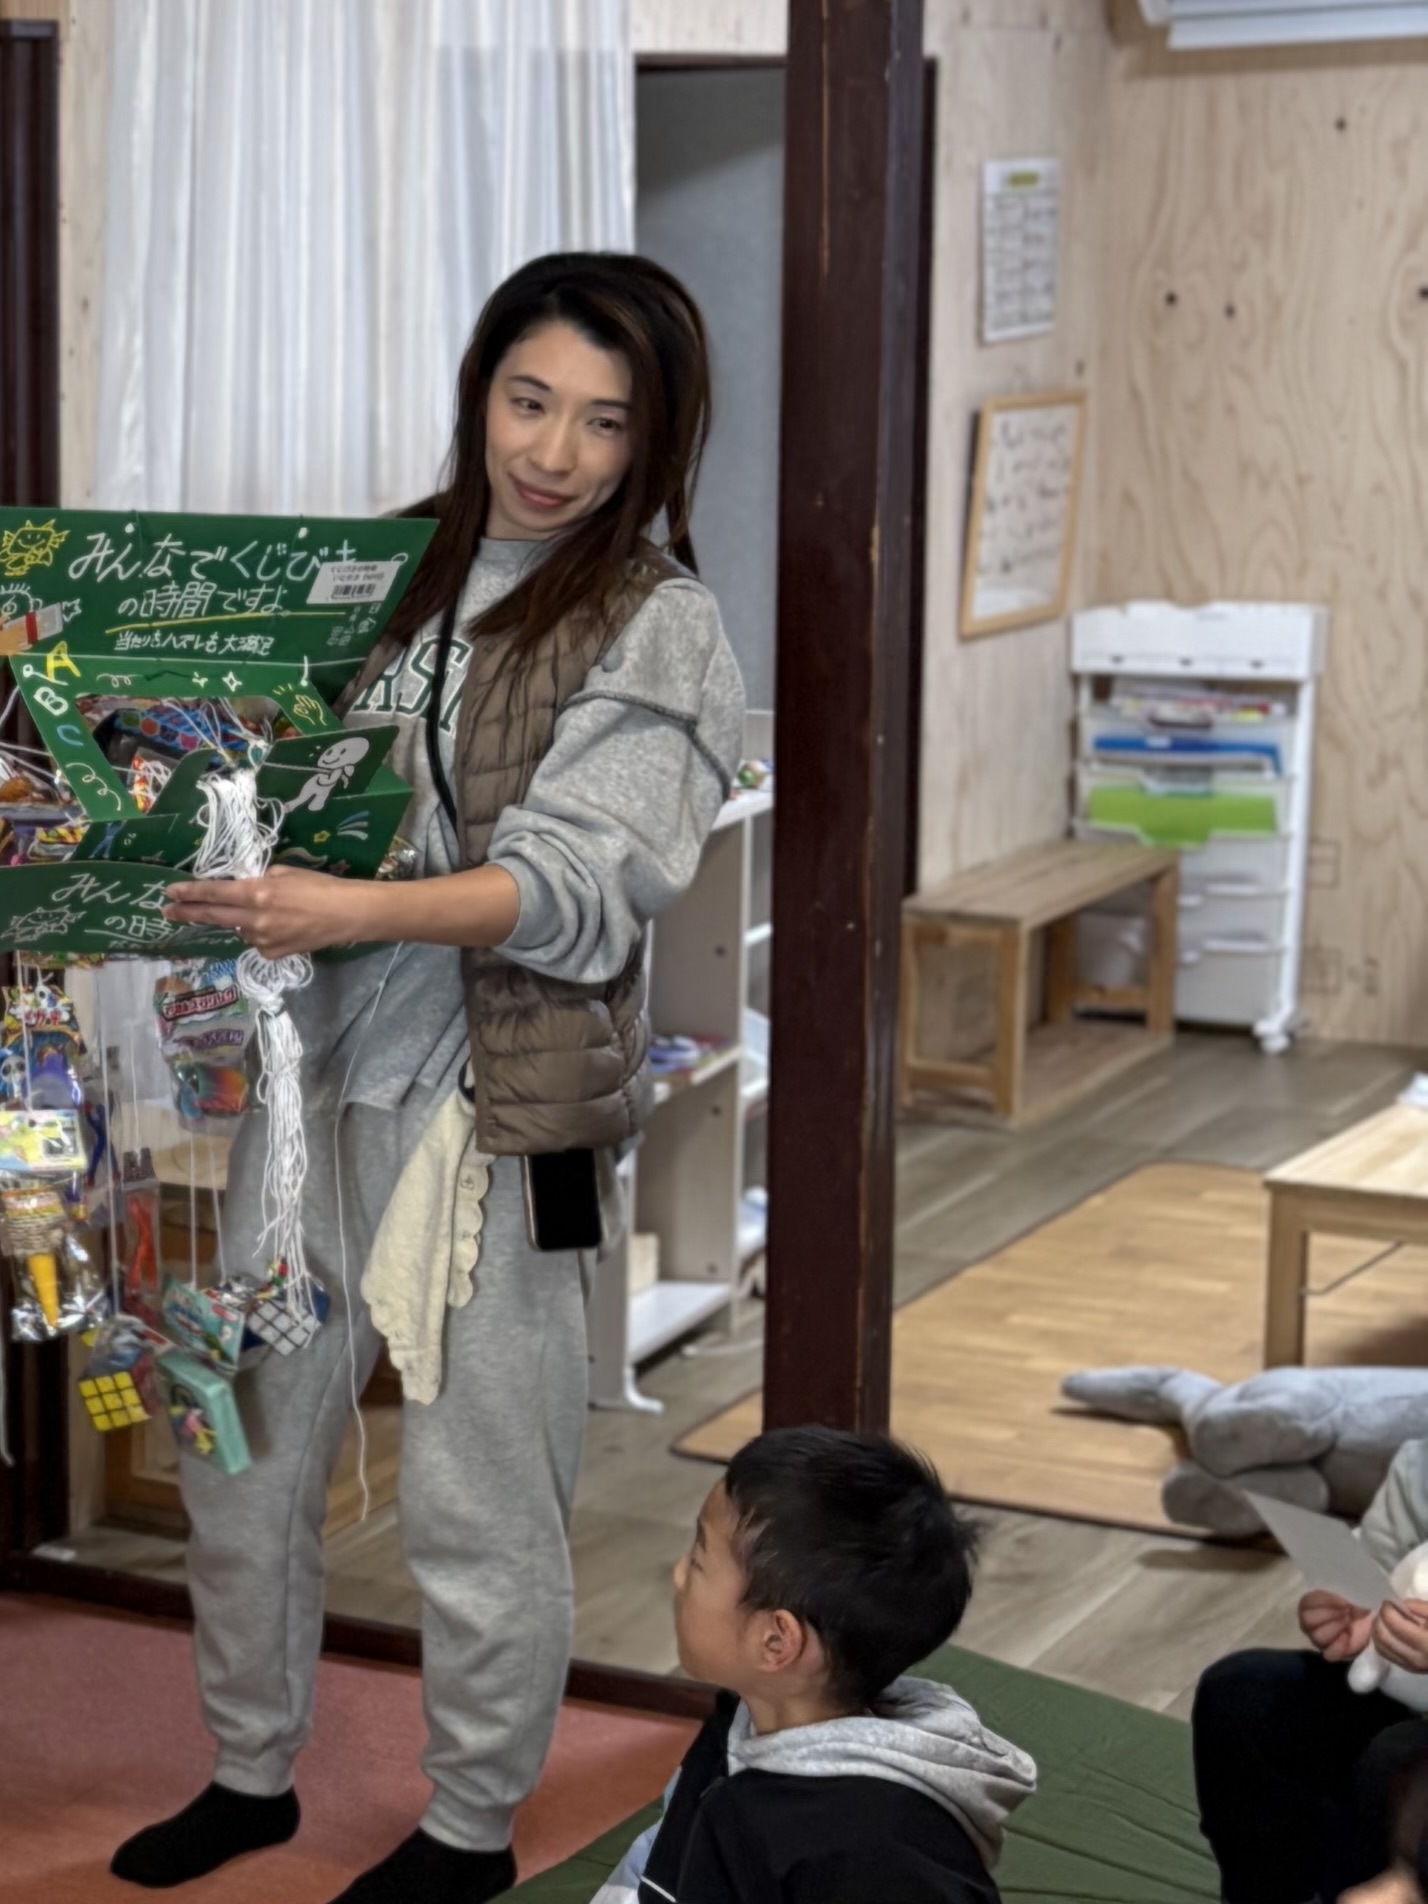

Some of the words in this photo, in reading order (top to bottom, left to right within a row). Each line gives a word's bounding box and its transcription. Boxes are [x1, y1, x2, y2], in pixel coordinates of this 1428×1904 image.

[47, 641, 82, 683] A
[33, 686, 70, 716] B
[56, 724, 84, 746] C
